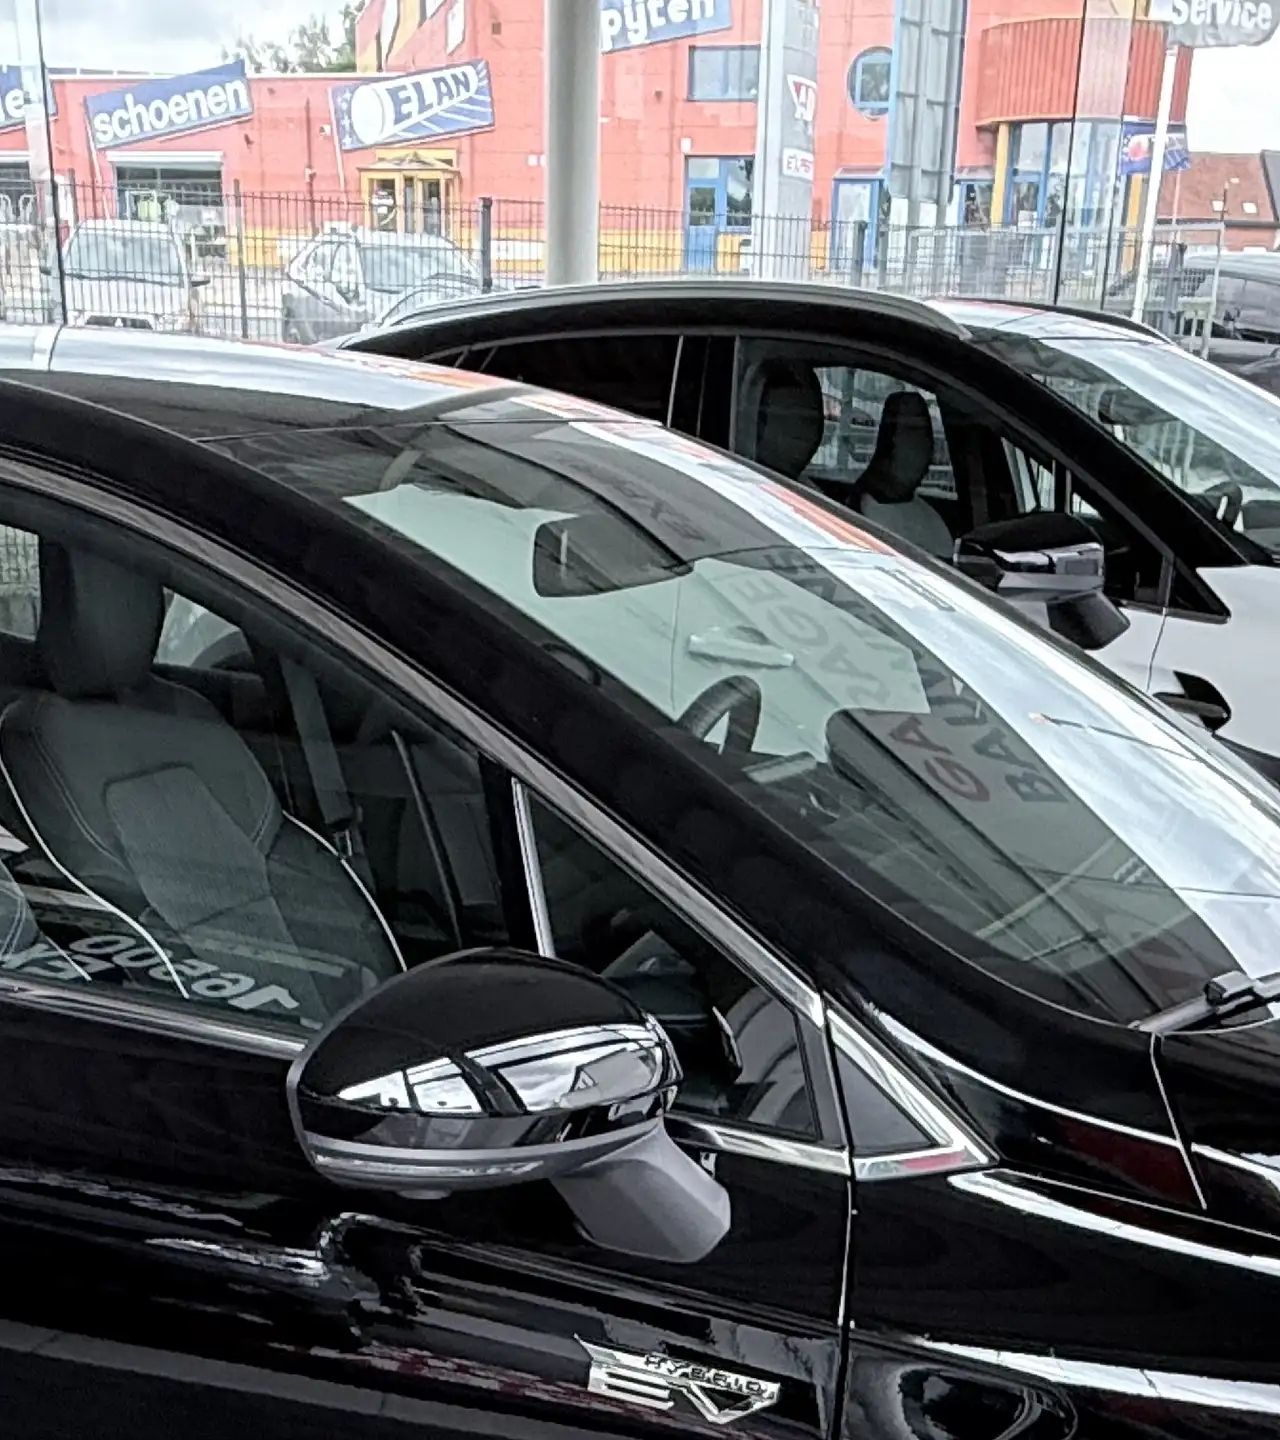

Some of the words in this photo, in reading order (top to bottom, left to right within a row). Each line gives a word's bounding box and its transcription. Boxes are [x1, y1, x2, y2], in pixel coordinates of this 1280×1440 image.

[1172, 0, 1272, 29] Service
[92, 78, 250, 142] schoenen
[386, 70, 470, 125] ELAN
[644, 1354, 762, 1394] HYBRID
